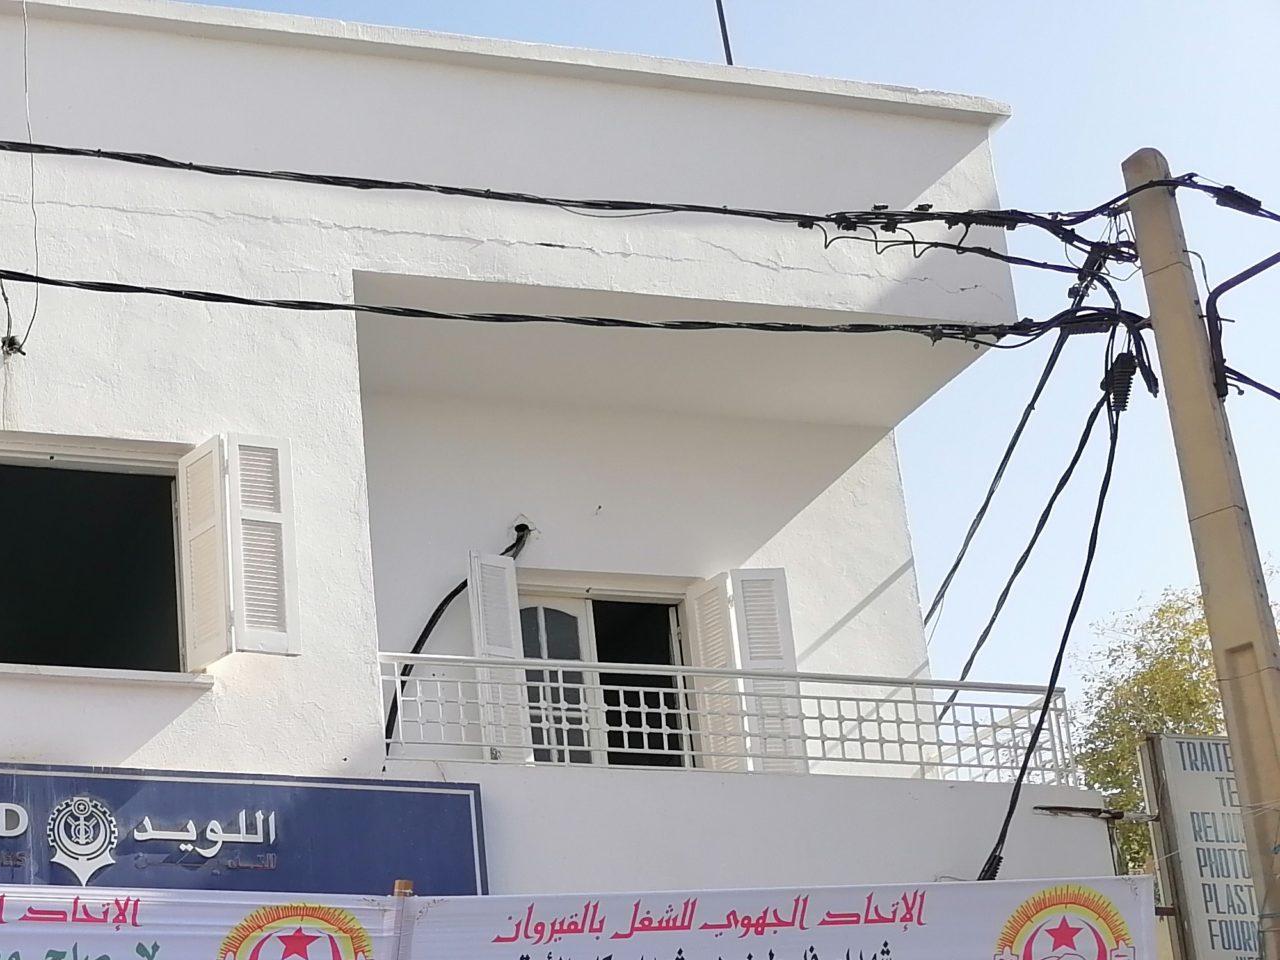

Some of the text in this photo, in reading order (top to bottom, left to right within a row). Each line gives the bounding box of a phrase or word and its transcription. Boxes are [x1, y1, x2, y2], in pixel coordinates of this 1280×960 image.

[133, 808, 276, 858] اللويد
[1196, 847, 1252, 879] PHOTO
[16, 890, 143, 931] الإتحاد
[492, 889, 925, 945] الإتحاد الجهوي للشغل بالقيروان
